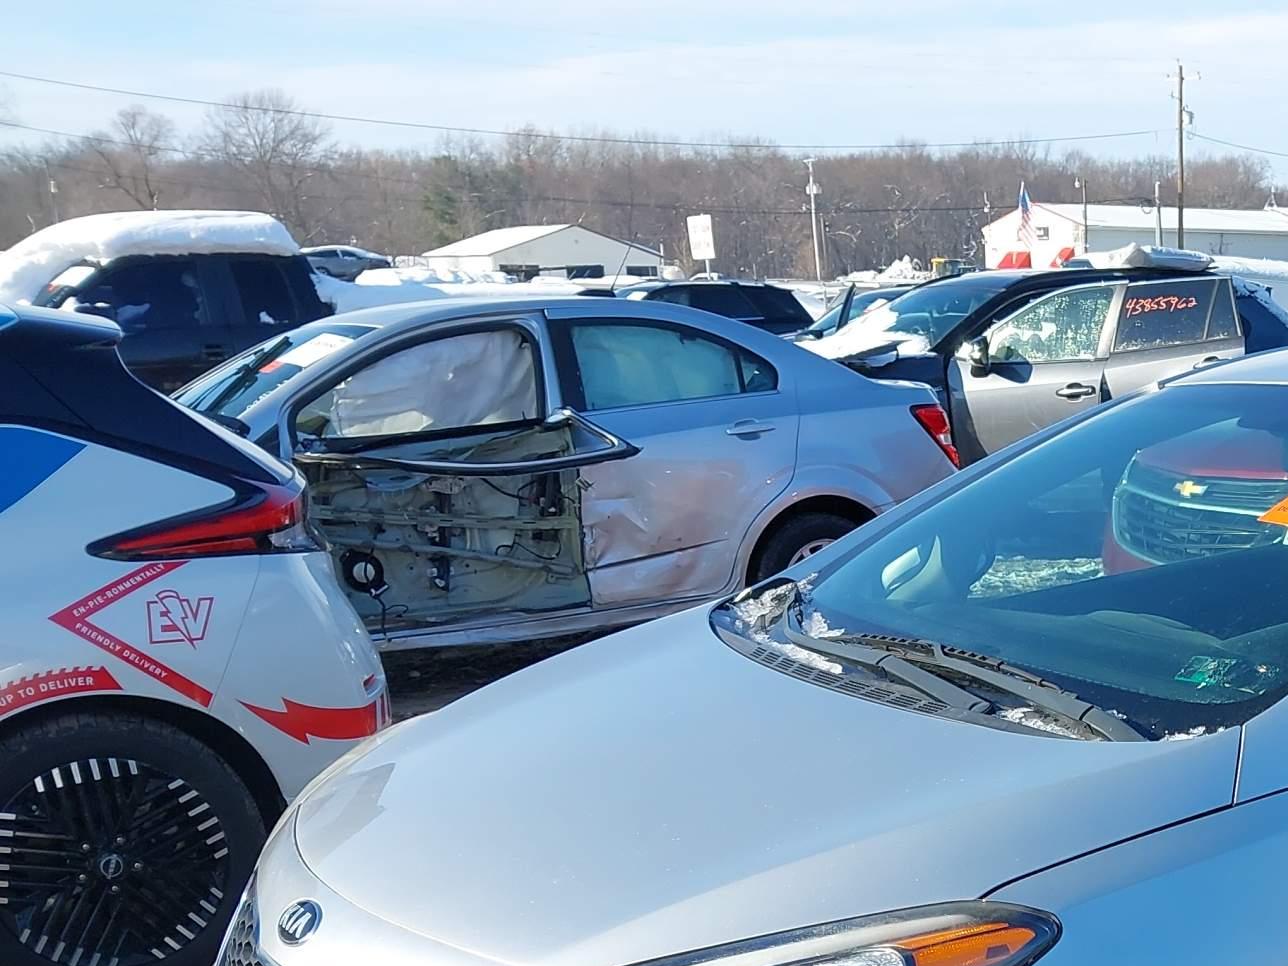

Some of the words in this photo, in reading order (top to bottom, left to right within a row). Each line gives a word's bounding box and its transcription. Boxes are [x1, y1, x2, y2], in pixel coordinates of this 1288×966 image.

[1126, 296, 1198, 319] 43855962
[75, 622, 122, 652] FRIENDLY
[123, 649, 168, 679] DELIVERY
[18, 687, 34, 698] TO
[39, 676, 94, 692] DELIVER
